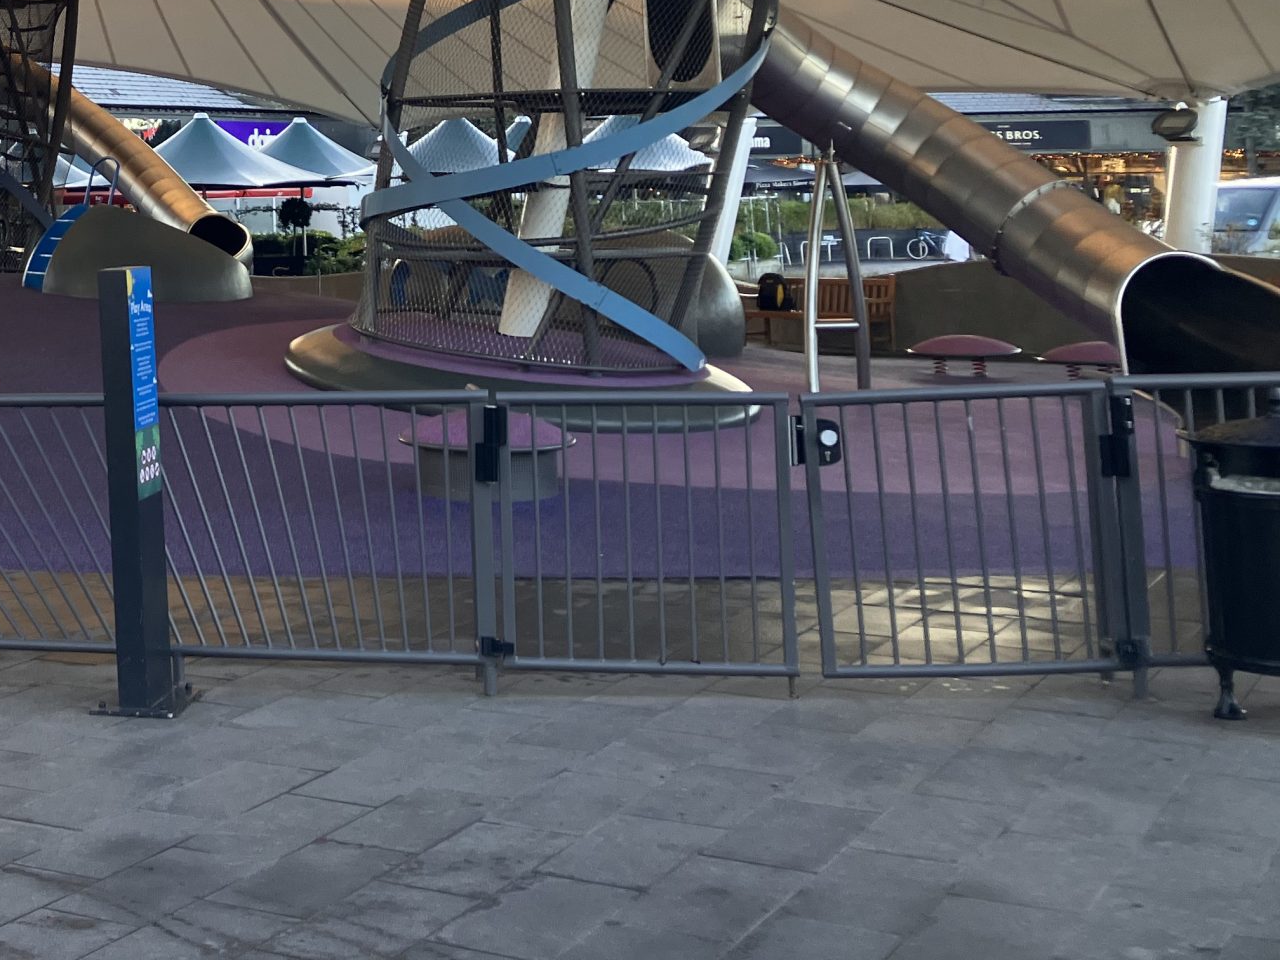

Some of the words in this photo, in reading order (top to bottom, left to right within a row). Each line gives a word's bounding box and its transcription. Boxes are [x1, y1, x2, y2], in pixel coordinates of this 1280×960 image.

[1006, 130, 1043, 140] BROS.
[130, 301, 140, 316] Play
[140, 299, 152, 313] Area
